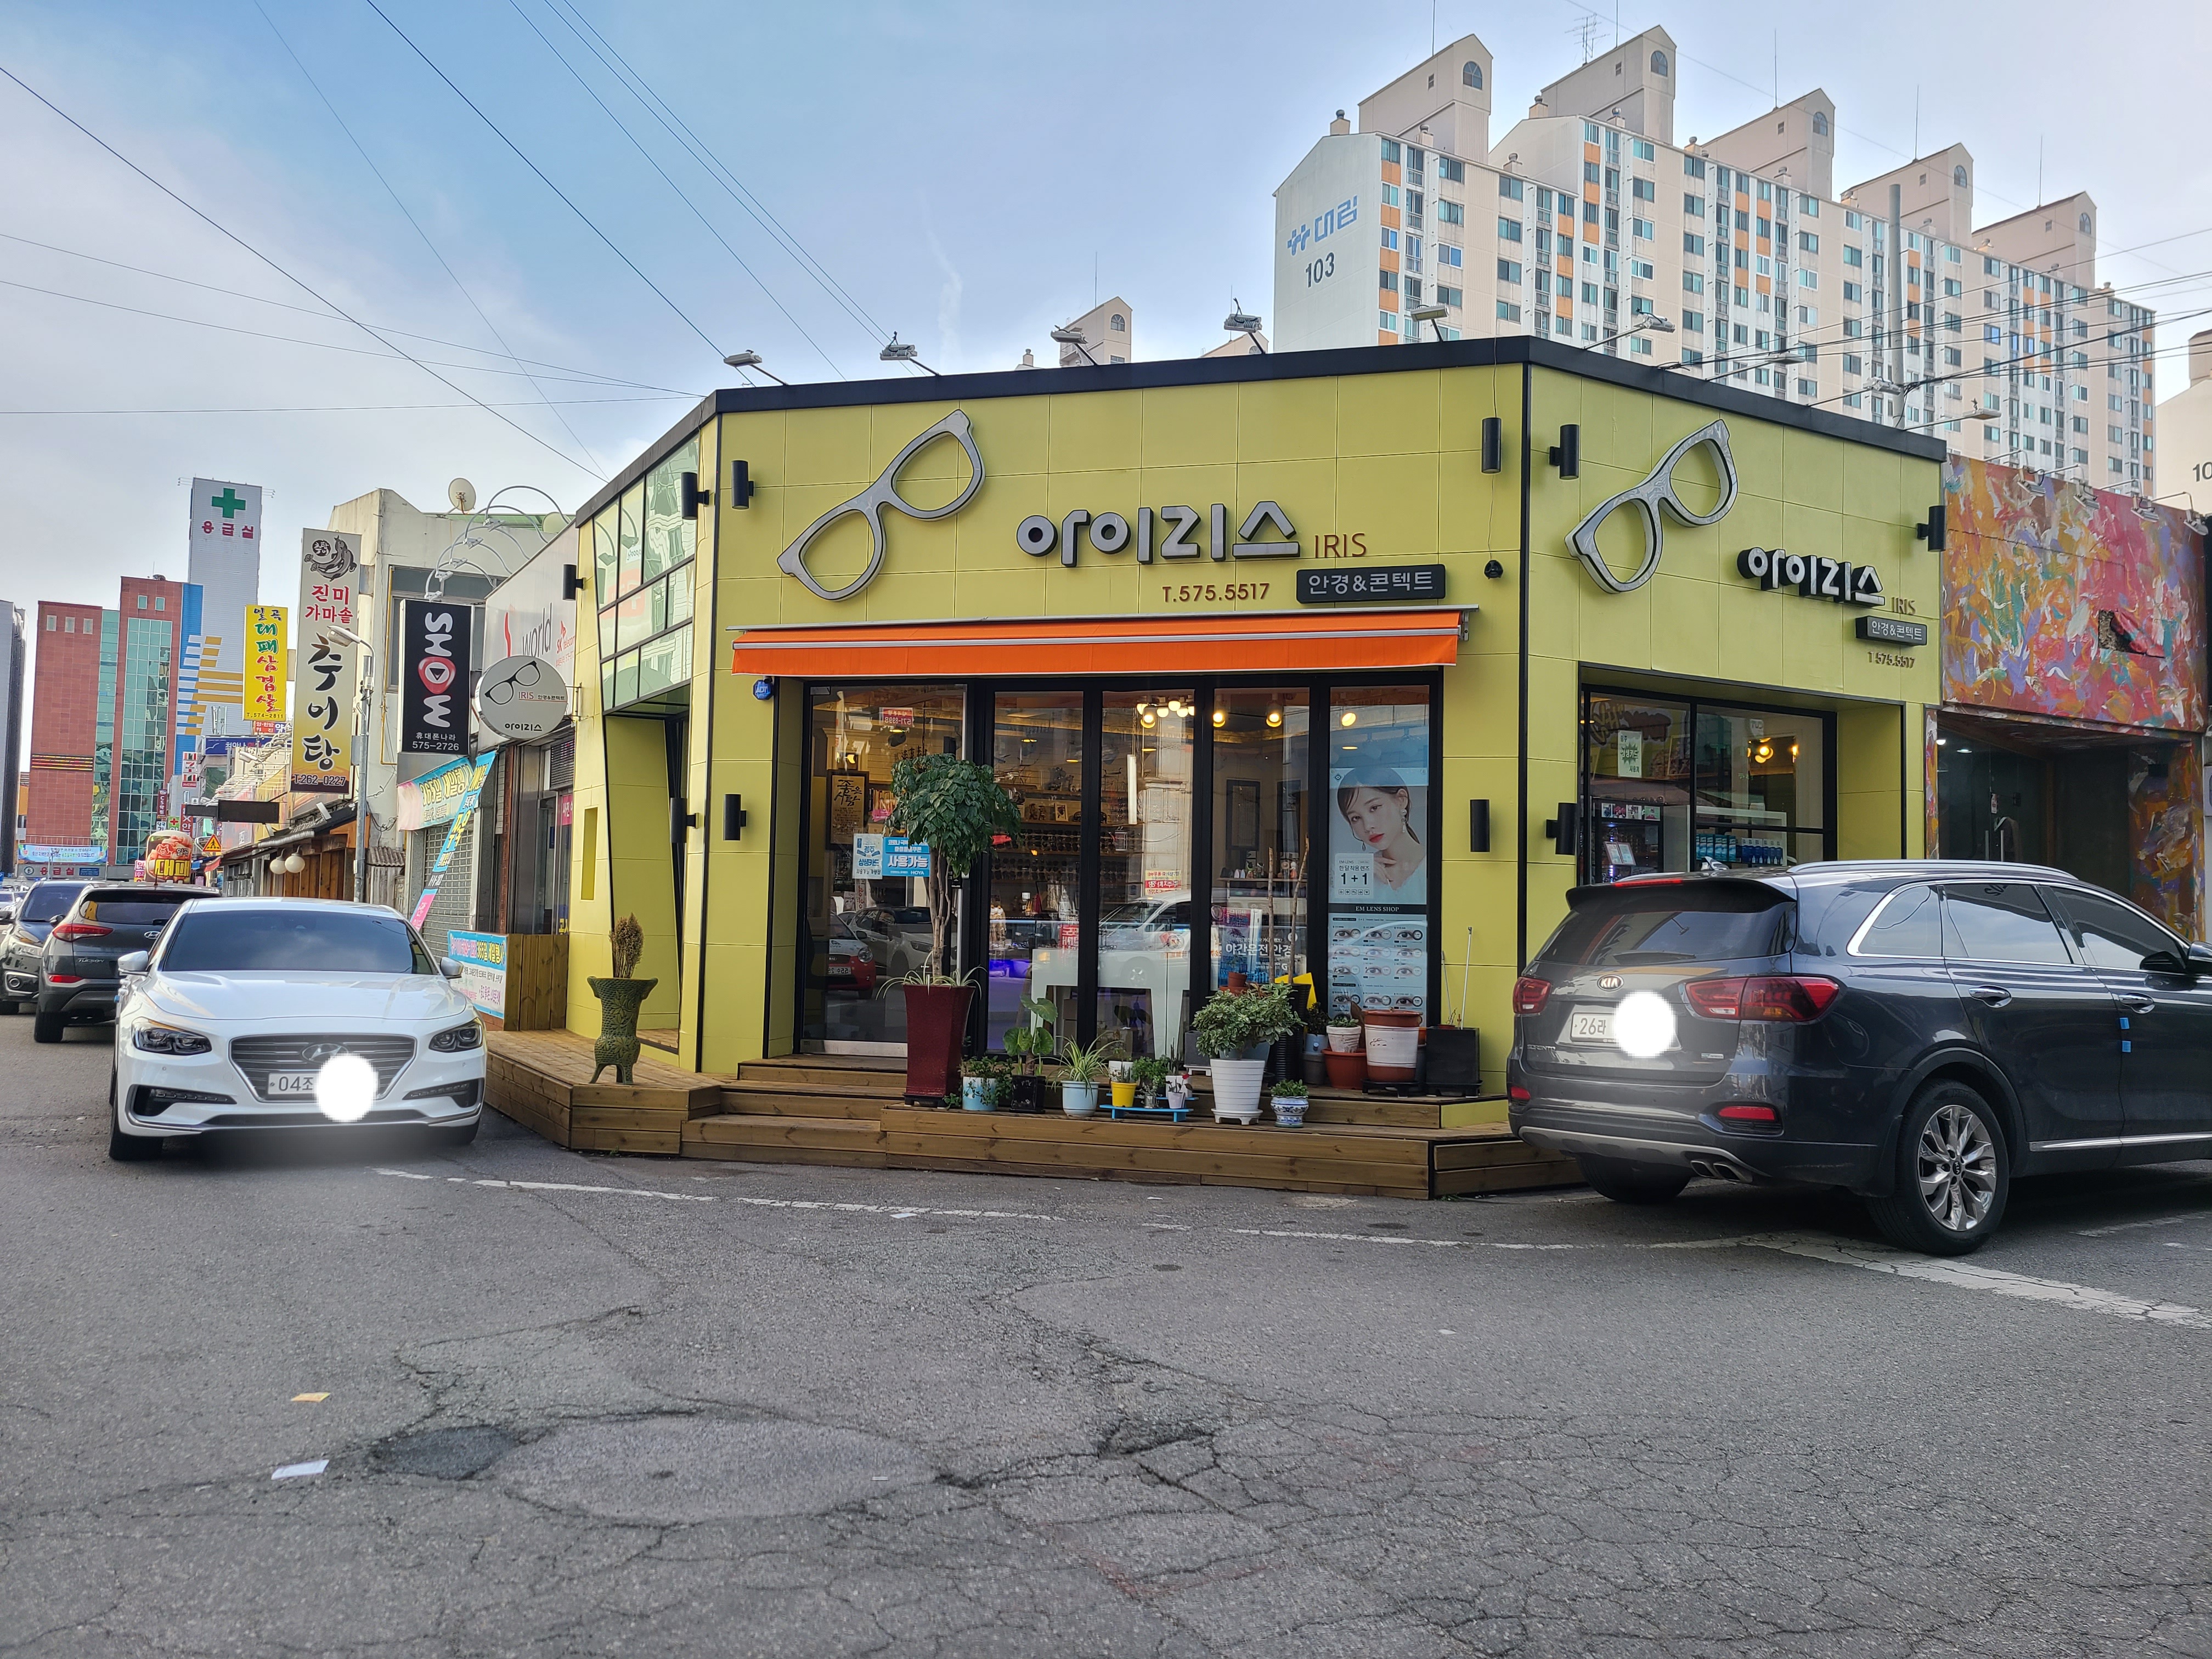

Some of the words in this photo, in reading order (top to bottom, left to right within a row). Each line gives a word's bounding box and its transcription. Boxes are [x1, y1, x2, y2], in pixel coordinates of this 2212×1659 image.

[1314, 195, 1358, 243] 대림
[1305, 252, 1335, 287] 103
[201, 520, 254, 539] 응급실
[1017, 500, 1301, 568] 아이리스
[1314, 533, 1368, 558] IRIS
[1308, 570, 1434, 596] 안경&콘텍트
[1738, 547, 1886, 608] 아이리스
[1891, 596, 1917, 616] IRIS
[311, 584, 349, 605] 진미
[1162, 583, 1271, 603] T.575.5517
[253, 607, 282, 621] 일곡
[304, 604, 353, 624] 가마솥
[522, 602, 552, 657] world
[1871, 620, 1922, 641] 안경&콘텍트
[418, 612, 456, 728] SHOW
[303, 632, 343, 770] 추어탕
[504, 723, 542, 731] 아이리스
[415, 732, 456, 741] 휴대폰나라
[412, 741, 459, 751] 575-2726
[419, 776, 442, 806] 365일
[837, 779, 862, 795] 좋은
[834, 792, 861, 806] 사람
[176, 848, 189, 856] 일곡
[888, 855, 928, 867] 사용가능
[40, 867, 74, 876] 응급실
[155, 859, 190, 877] 대패
[1225, 943, 1268, 956] 야간운전
[1600, 978, 1620, 988] KIA
[1579, 1018, 1607, 1035] 26라
[279, 1076, 314, 1091] 04조
